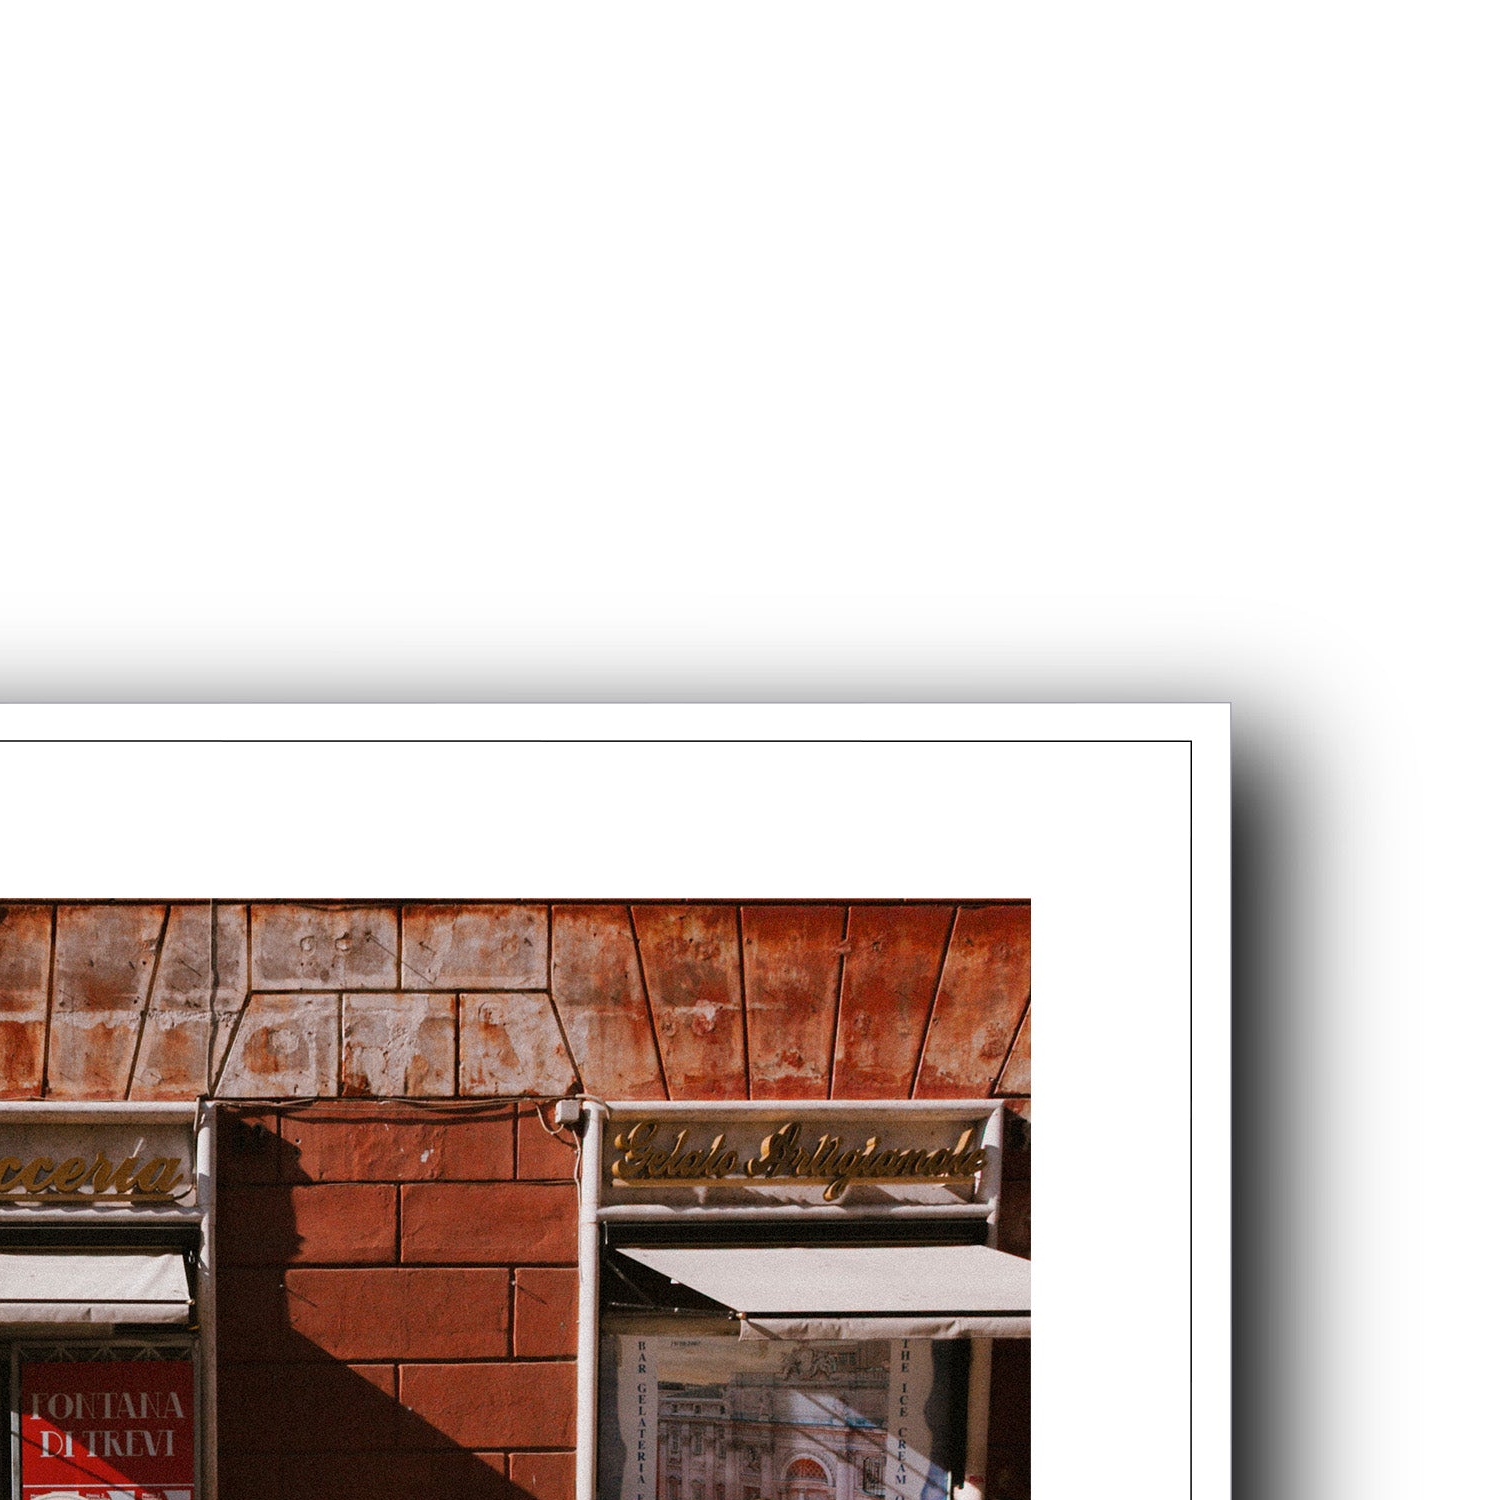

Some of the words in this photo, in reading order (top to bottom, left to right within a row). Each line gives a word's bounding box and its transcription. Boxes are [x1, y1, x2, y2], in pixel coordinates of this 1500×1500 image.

[611, 1121, 739, 1180] Gelato
[744, 1122, 989, 1201] Artigianale
[637, 1341, 647, 1374] BAR
[901, 1338, 910, 1373] THE
[29, 1391, 186, 1420] FONTANA
[899, 1383, 909, 1417] ICE
[39, 1430, 76, 1458] DI
[82, 1430, 176, 1458] TREVI
[636, 1383, 647, 1484] GELATERIA
[895, 1427, 907, 1485] CREAM
